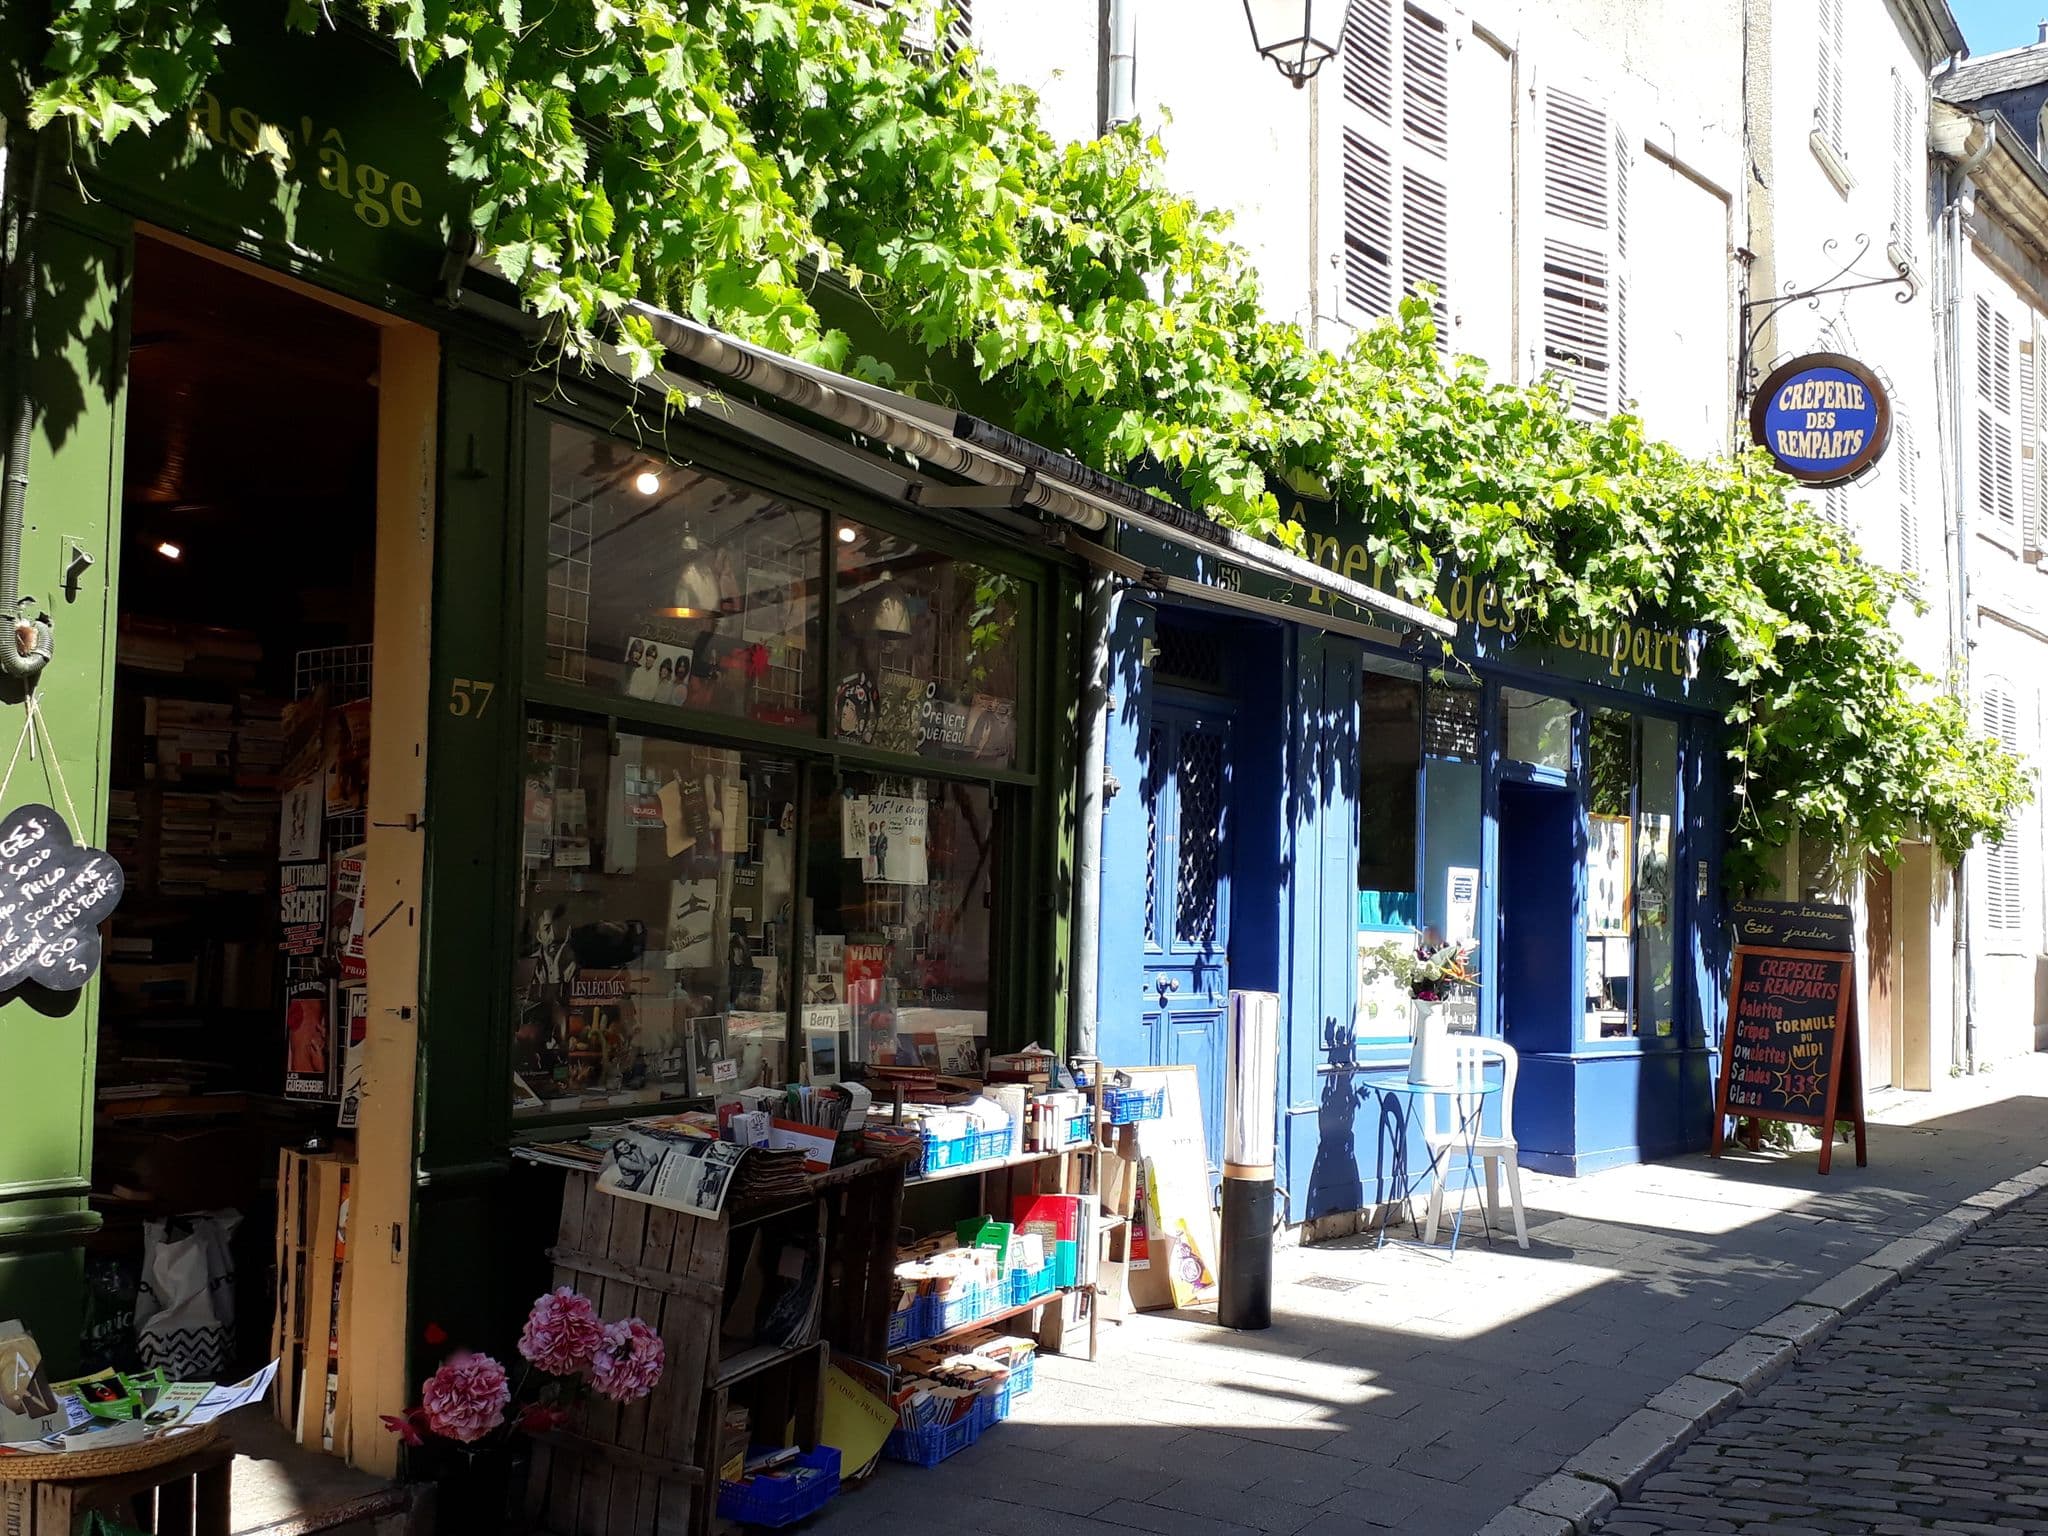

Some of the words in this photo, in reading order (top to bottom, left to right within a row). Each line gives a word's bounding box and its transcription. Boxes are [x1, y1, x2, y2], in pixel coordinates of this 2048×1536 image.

[1779, 379, 1865, 411] CRÊPERIE
[1806, 412, 1836, 429] DES
[1776, 430, 1864, 459] REMPARTS
[1219, 564, 1241, 592] 59
[1450, 573, 1516, 632] des
[449, 678, 495, 719] 57
[281, 890, 326, 923] SECRET
[1783, 927, 1836, 943] jardin
[851, 947, 884, 961] VIAN
[571, 979, 588, 997] LES
[588, 976, 625, 997] LÉGUMES
[1744, 981, 1761, 993] DES
[1764, 978, 1839, 1001] REMPARTS
[810, 1012, 836, 1027] Berry
[1740, 996, 1784, 1020] Galettes
[1775, 1015, 1836, 1035] FORMULE
[1801, 1033, 1813, 1043] DU
[1792, 1043, 1824, 1059] MIDI
[1731, 1062, 1771, 1085] Salades
[1729, 1083, 1763, 1106] Glaces
